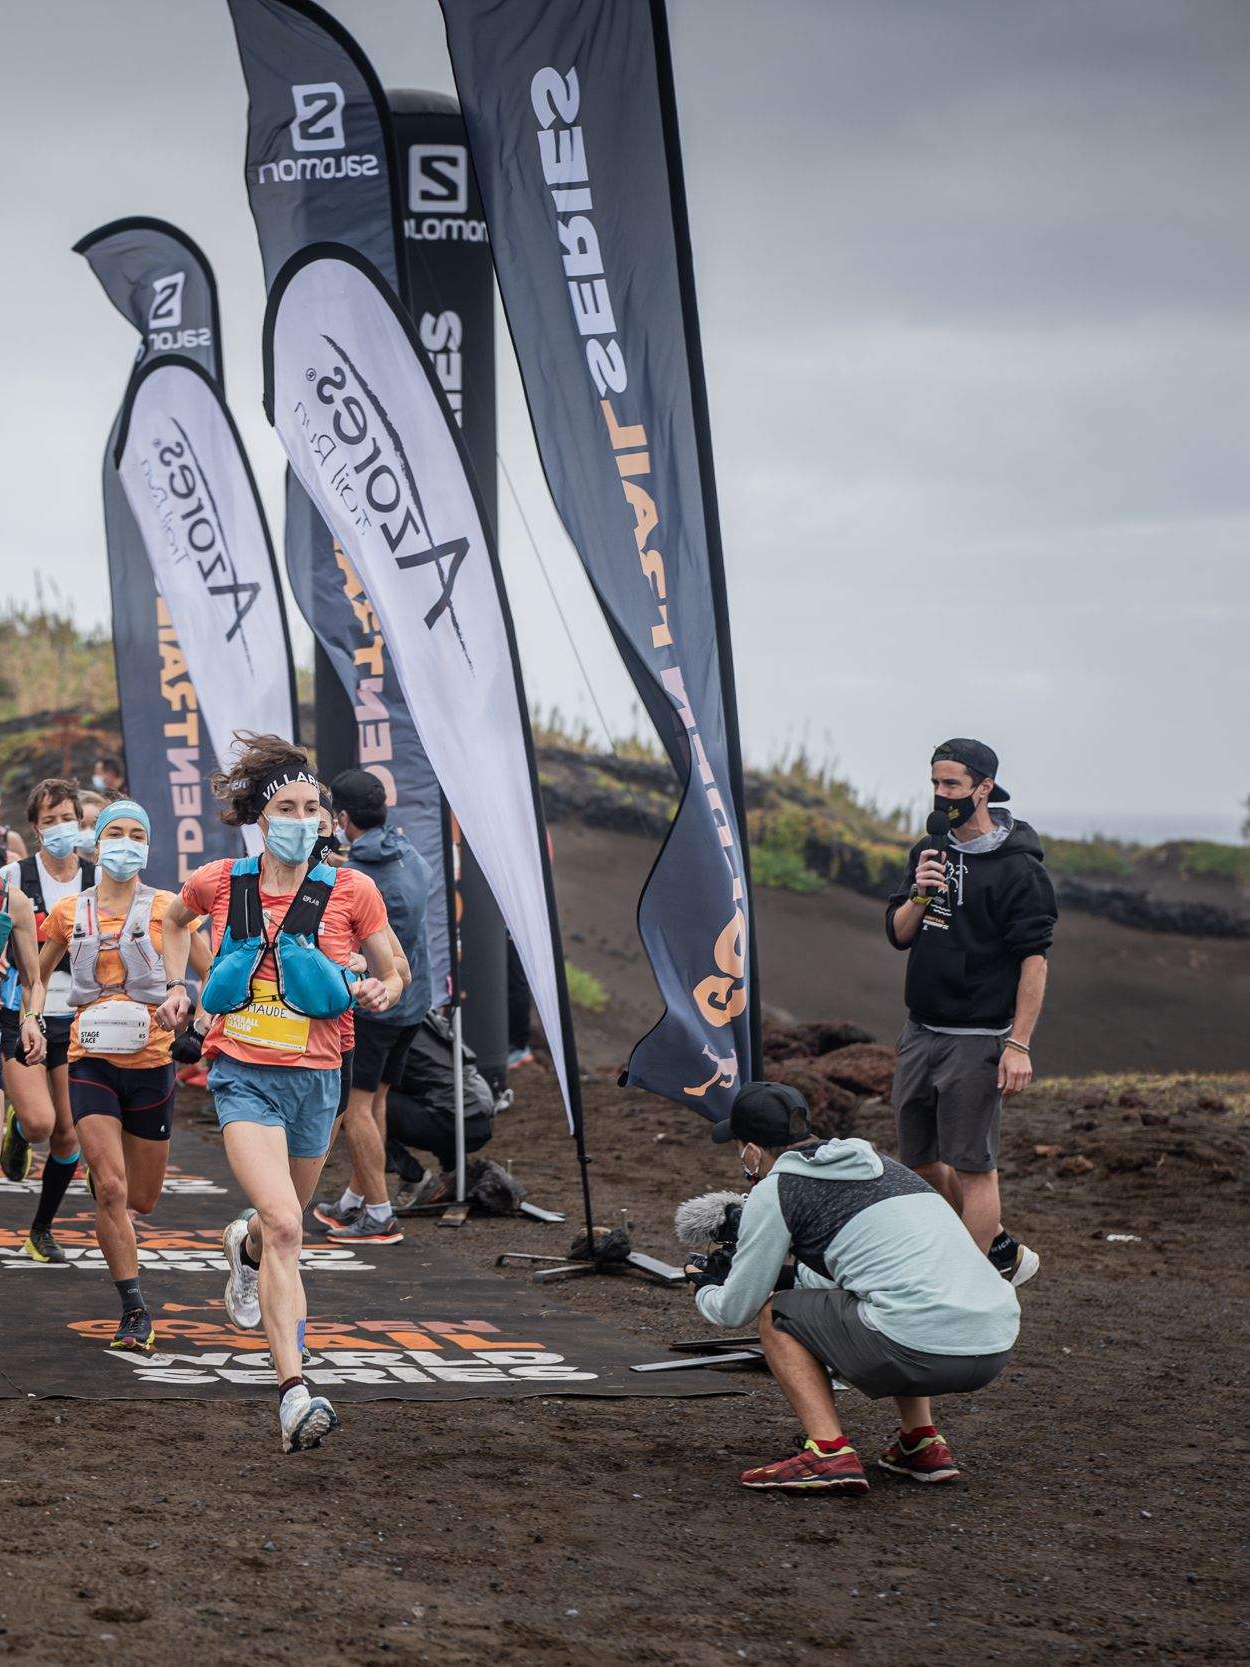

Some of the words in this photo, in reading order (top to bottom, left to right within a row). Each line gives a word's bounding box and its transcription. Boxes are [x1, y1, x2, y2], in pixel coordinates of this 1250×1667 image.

[404, 218, 489, 242] lomon
[262, 771, 320, 800] VILLAR
[102, 1350, 565, 1367] WORLD
[132, 1366, 599, 1385] SERIES
